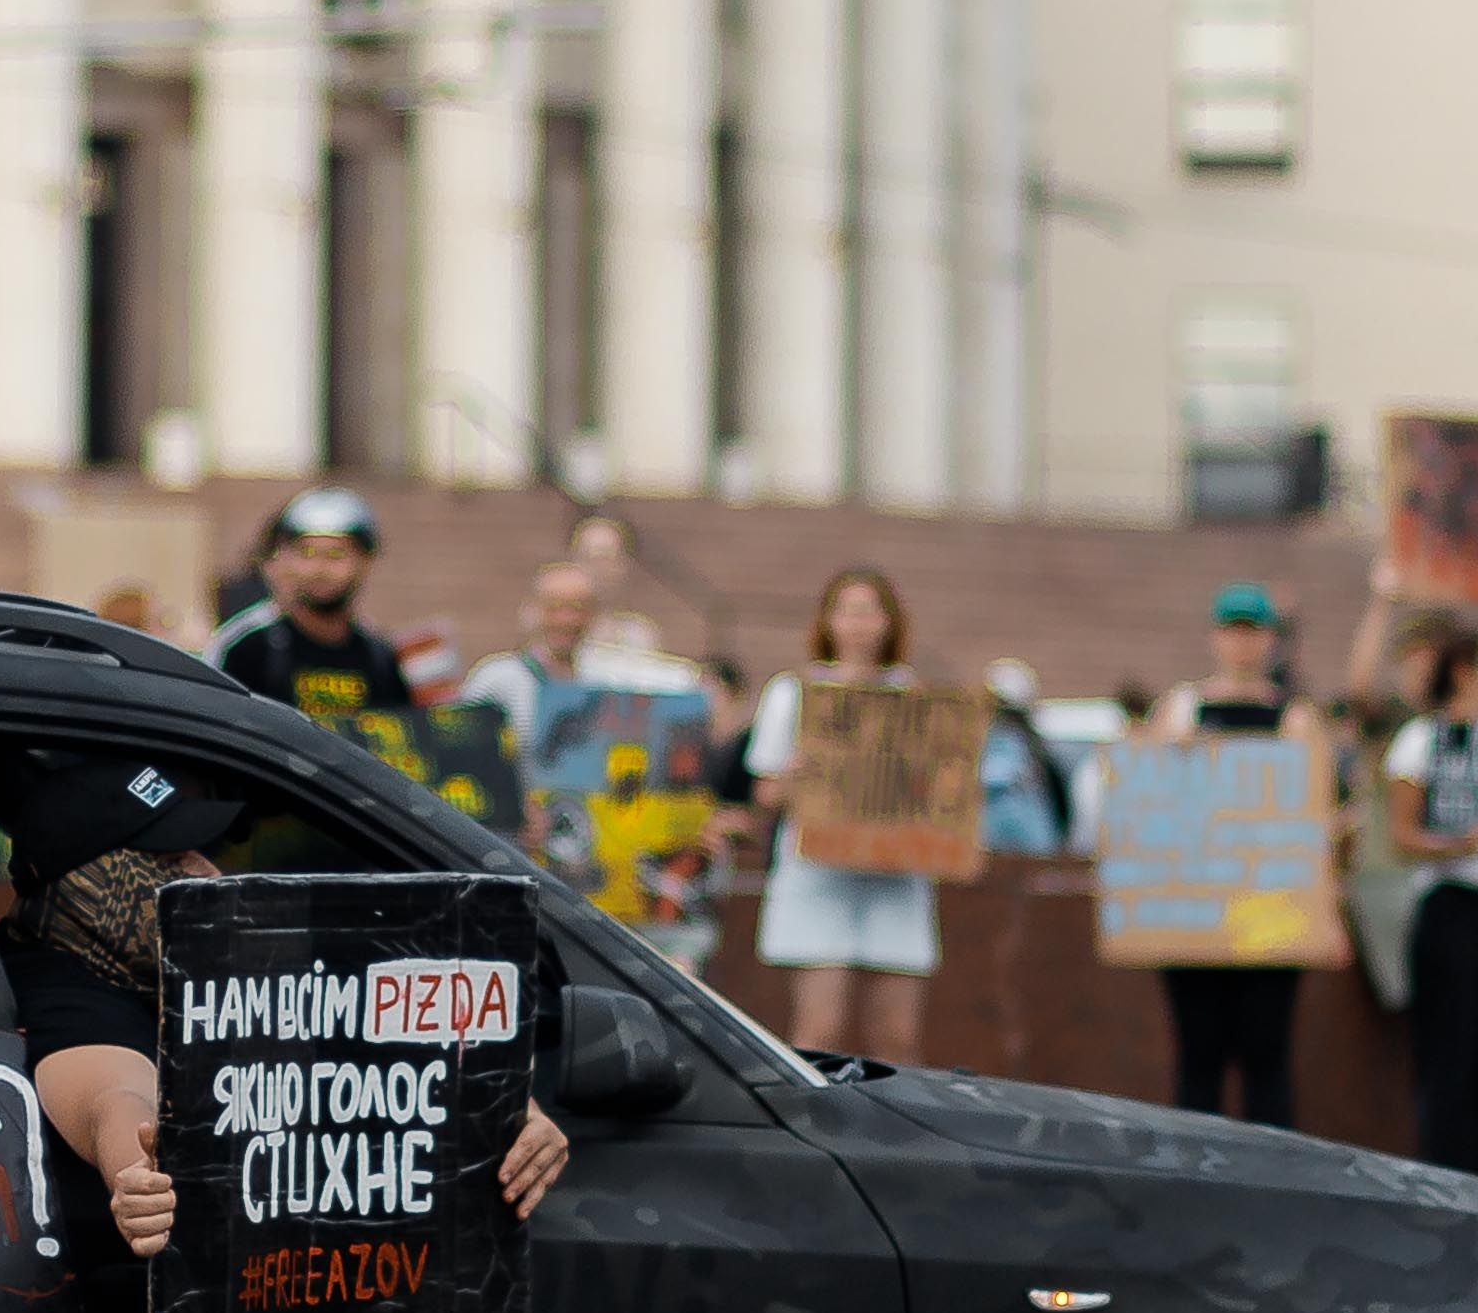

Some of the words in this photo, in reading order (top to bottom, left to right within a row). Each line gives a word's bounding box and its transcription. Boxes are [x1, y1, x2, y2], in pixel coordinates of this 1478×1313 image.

[182, 975, 271, 1045] НАМ
[374, 970, 509, 1036] PIZDA
[310, 1059, 448, 1126] ГОЛОС
[238, 1241, 431, 1313] #FREEAZOV
